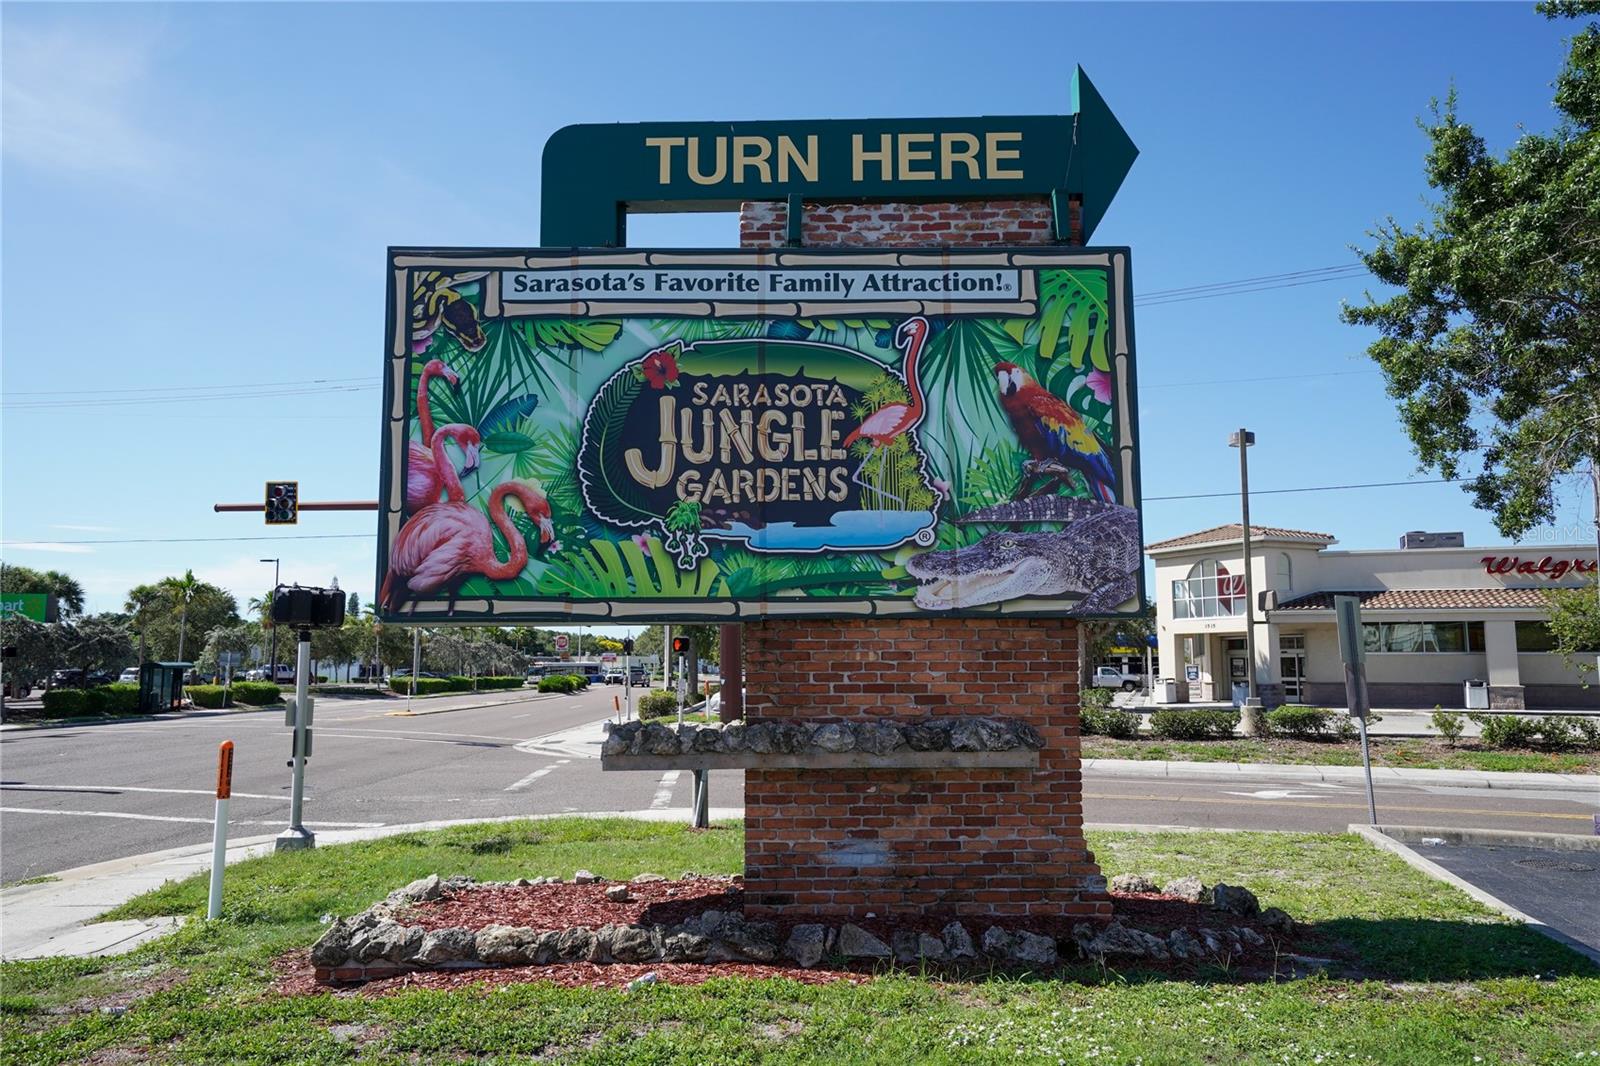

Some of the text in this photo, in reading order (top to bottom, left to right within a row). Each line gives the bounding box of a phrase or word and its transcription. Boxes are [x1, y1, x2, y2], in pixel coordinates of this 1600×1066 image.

[645, 132, 1024, 186] TURN HERE
[513, 272, 646, 293] Sarasota’s
[654, 272, 760, 293] Favorite
[769, 272, 856, 299] Family
[692, 381, 848, 408] SARASOTA
[624, 393, 848, 489] JUNGLE
[676, 466, 849, 505] GARDENS
